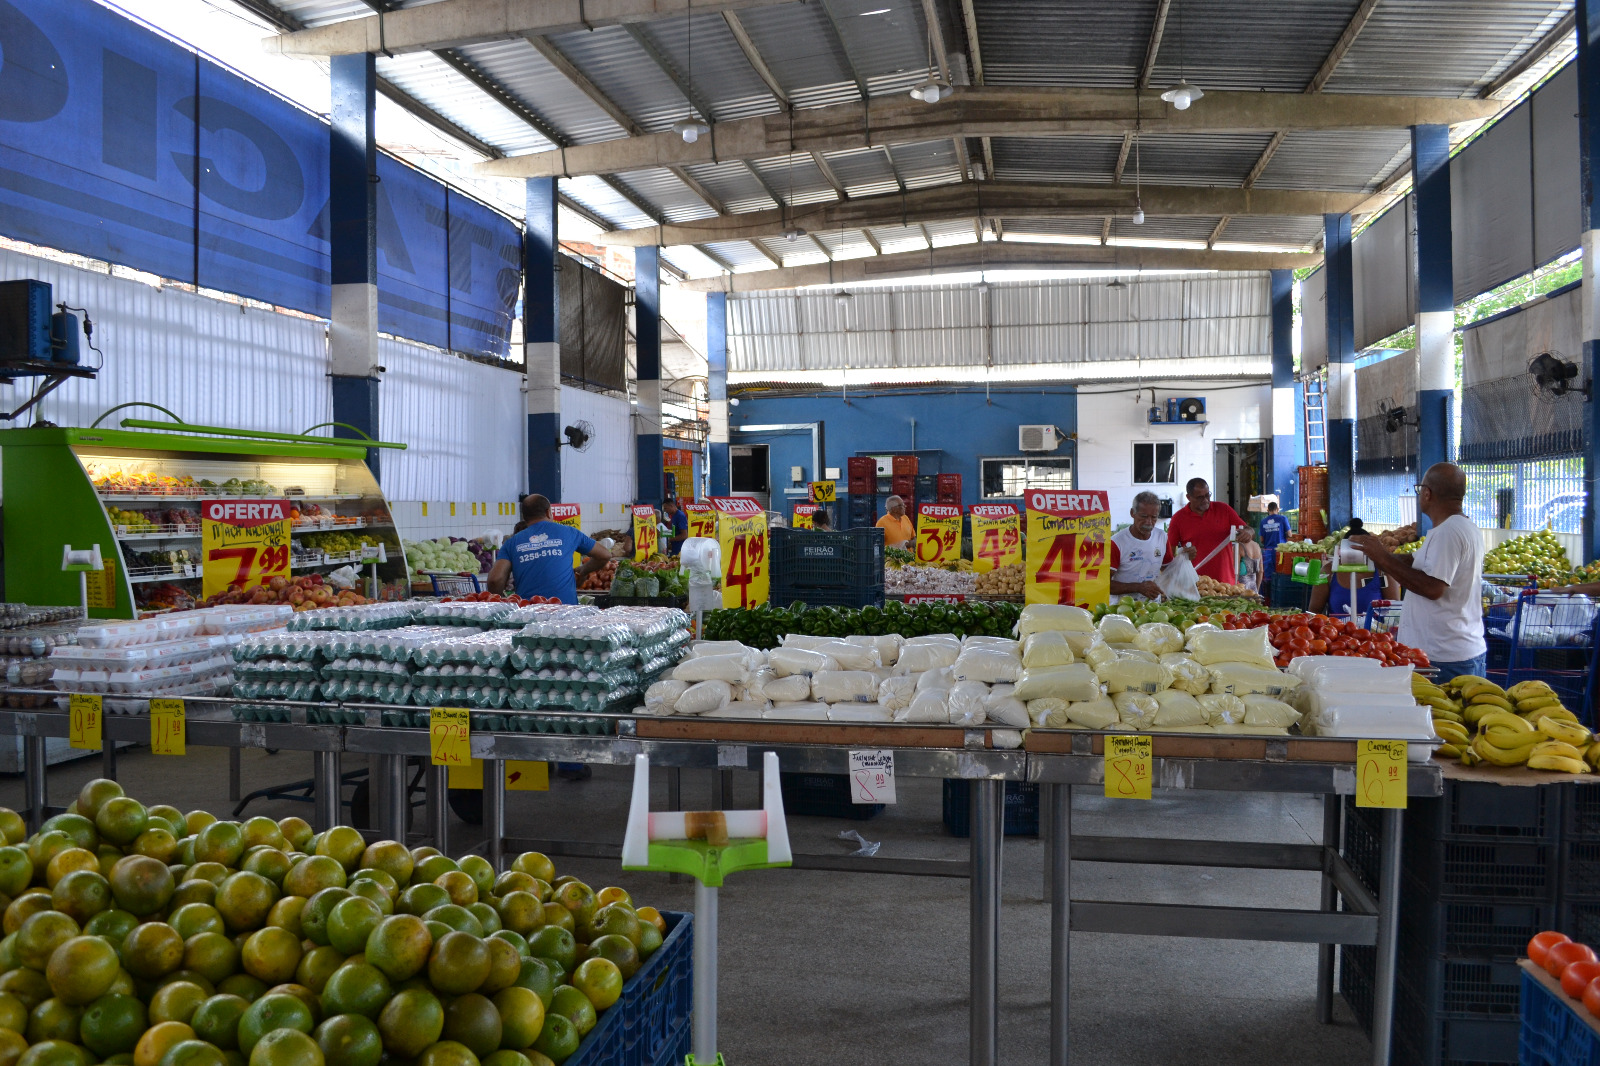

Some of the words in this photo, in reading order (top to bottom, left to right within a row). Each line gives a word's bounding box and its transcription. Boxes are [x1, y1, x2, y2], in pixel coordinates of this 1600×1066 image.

[715, 498, 762, 511] OFERTA
[1031, 493, 1104, 511] OFERTA
[209, 503, 284, 519] OFERTA
[550, 506, 578, 517] FERTA
[633, 506, 654, 516] OFERTA
[796, 506, 817, 514] OFERTA
[922, 505, 959, 516] OFERTA
[973, 505, 1016, 515] OFERTA
[804, 545, 834, 553] FEIRÃO
